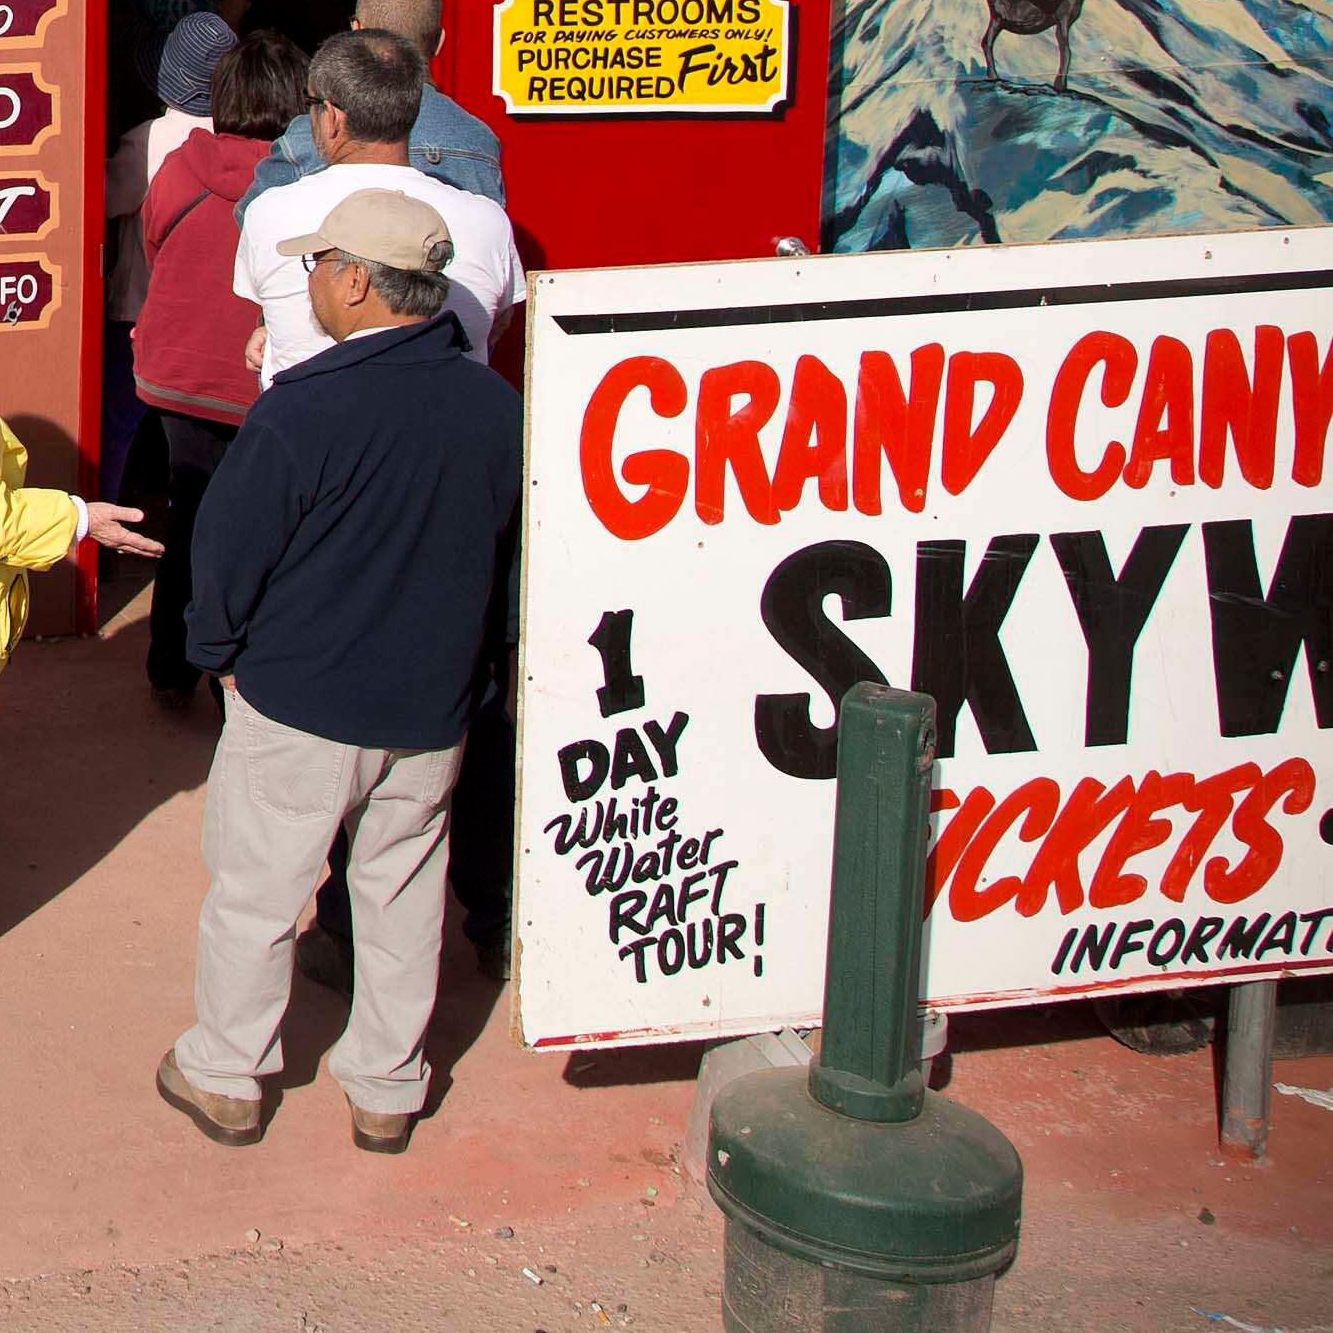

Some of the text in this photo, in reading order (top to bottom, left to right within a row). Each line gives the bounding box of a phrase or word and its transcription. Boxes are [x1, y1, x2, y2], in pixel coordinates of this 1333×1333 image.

[510, 28, 774, 46] FOR PAYING CUSTOMERS ONLY!
[517, 43, 779, 95] PURCHASE First
[527, 76, 676, 102] REQUIRED
[579, 343, 1024, 541] GRAND
[587, 609, 645, 718] 1
[557, 712, 690, 804] DAY
[544, 793, 678, 856] White
[923, 757, 1317, 922] ICKETS
[576, 829, 724, 897] Water
[608, 860, 739, 946] RAFT
[618, 903, 766, 984] TOUR!
[1051, 907, 1333, 975] INFORMAT
